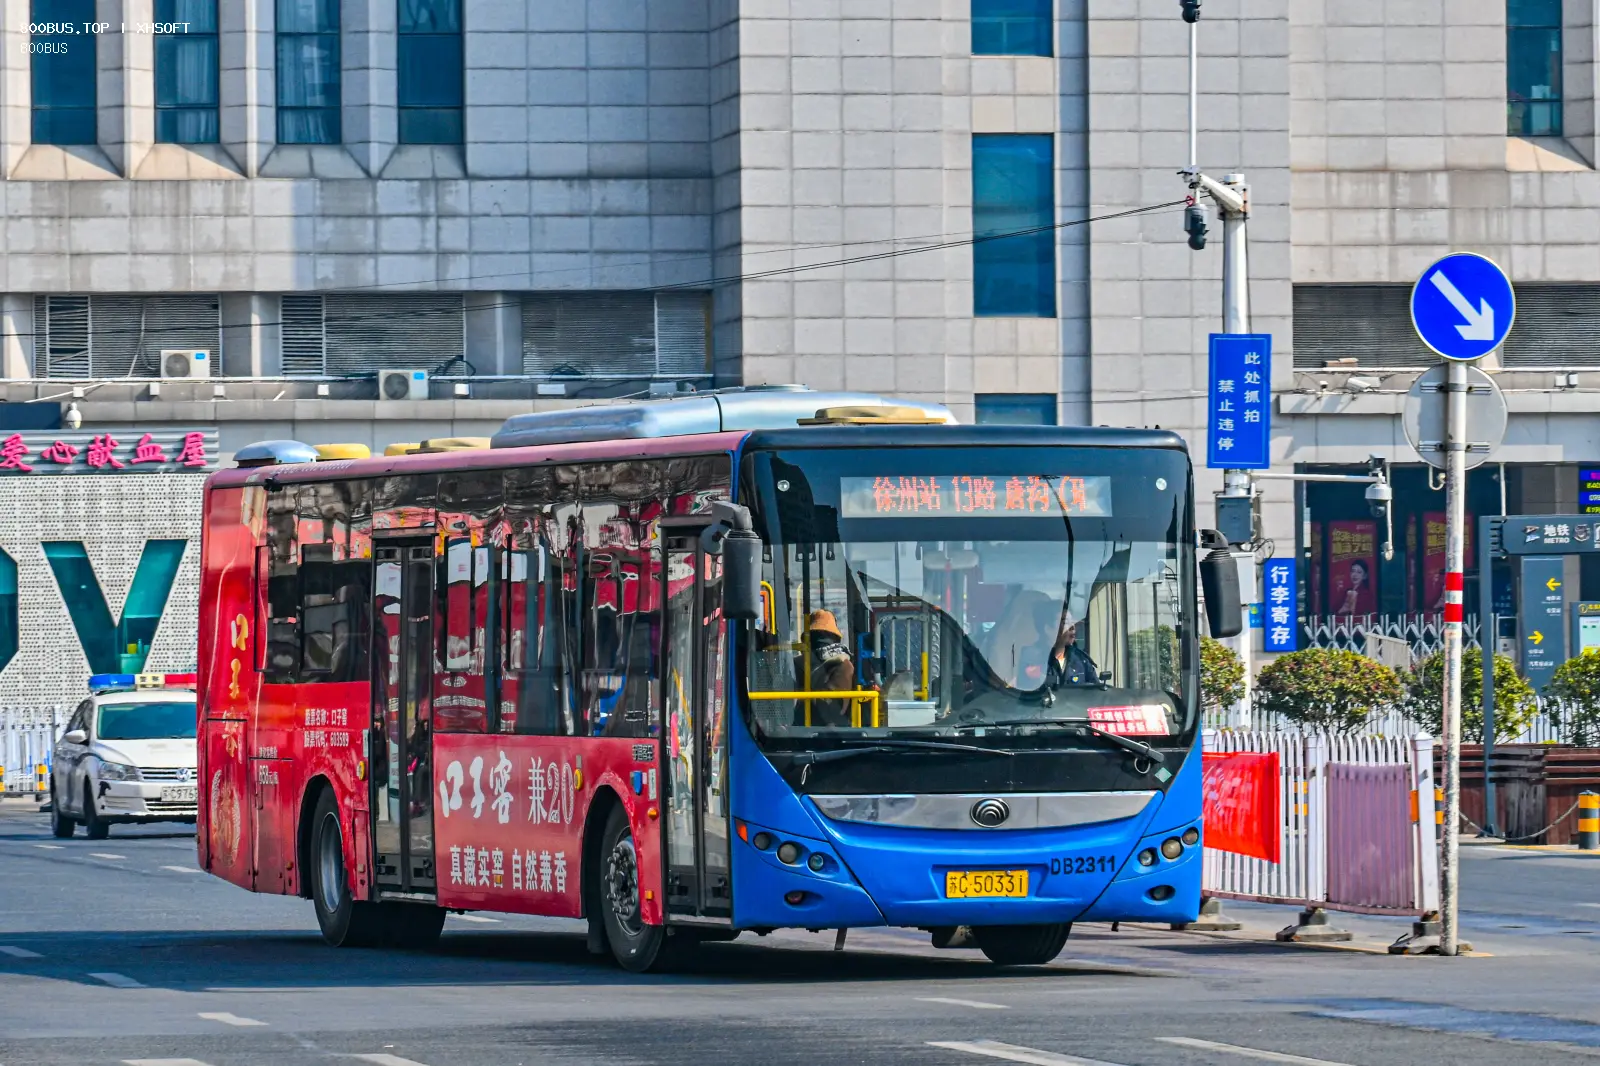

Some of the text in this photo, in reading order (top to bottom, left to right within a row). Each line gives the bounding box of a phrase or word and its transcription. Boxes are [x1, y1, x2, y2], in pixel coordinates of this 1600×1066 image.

[1243, 352, 1261, 422] 此处抓拍
[1217, 380, 1235, 451] 禁止违停
[0, 431, 207, 472] 爱心献血屋
[872, 476, 941, 512] 徐州站
[951, 476, 996, 512] 13路
[1543, 523, 1570, 537] 地铁
[1270, 565, 1291, 645] 行李寄存
[511, 848, 567, 894] 自然兼香
[1050, 855, 1116, 876] DB2311
